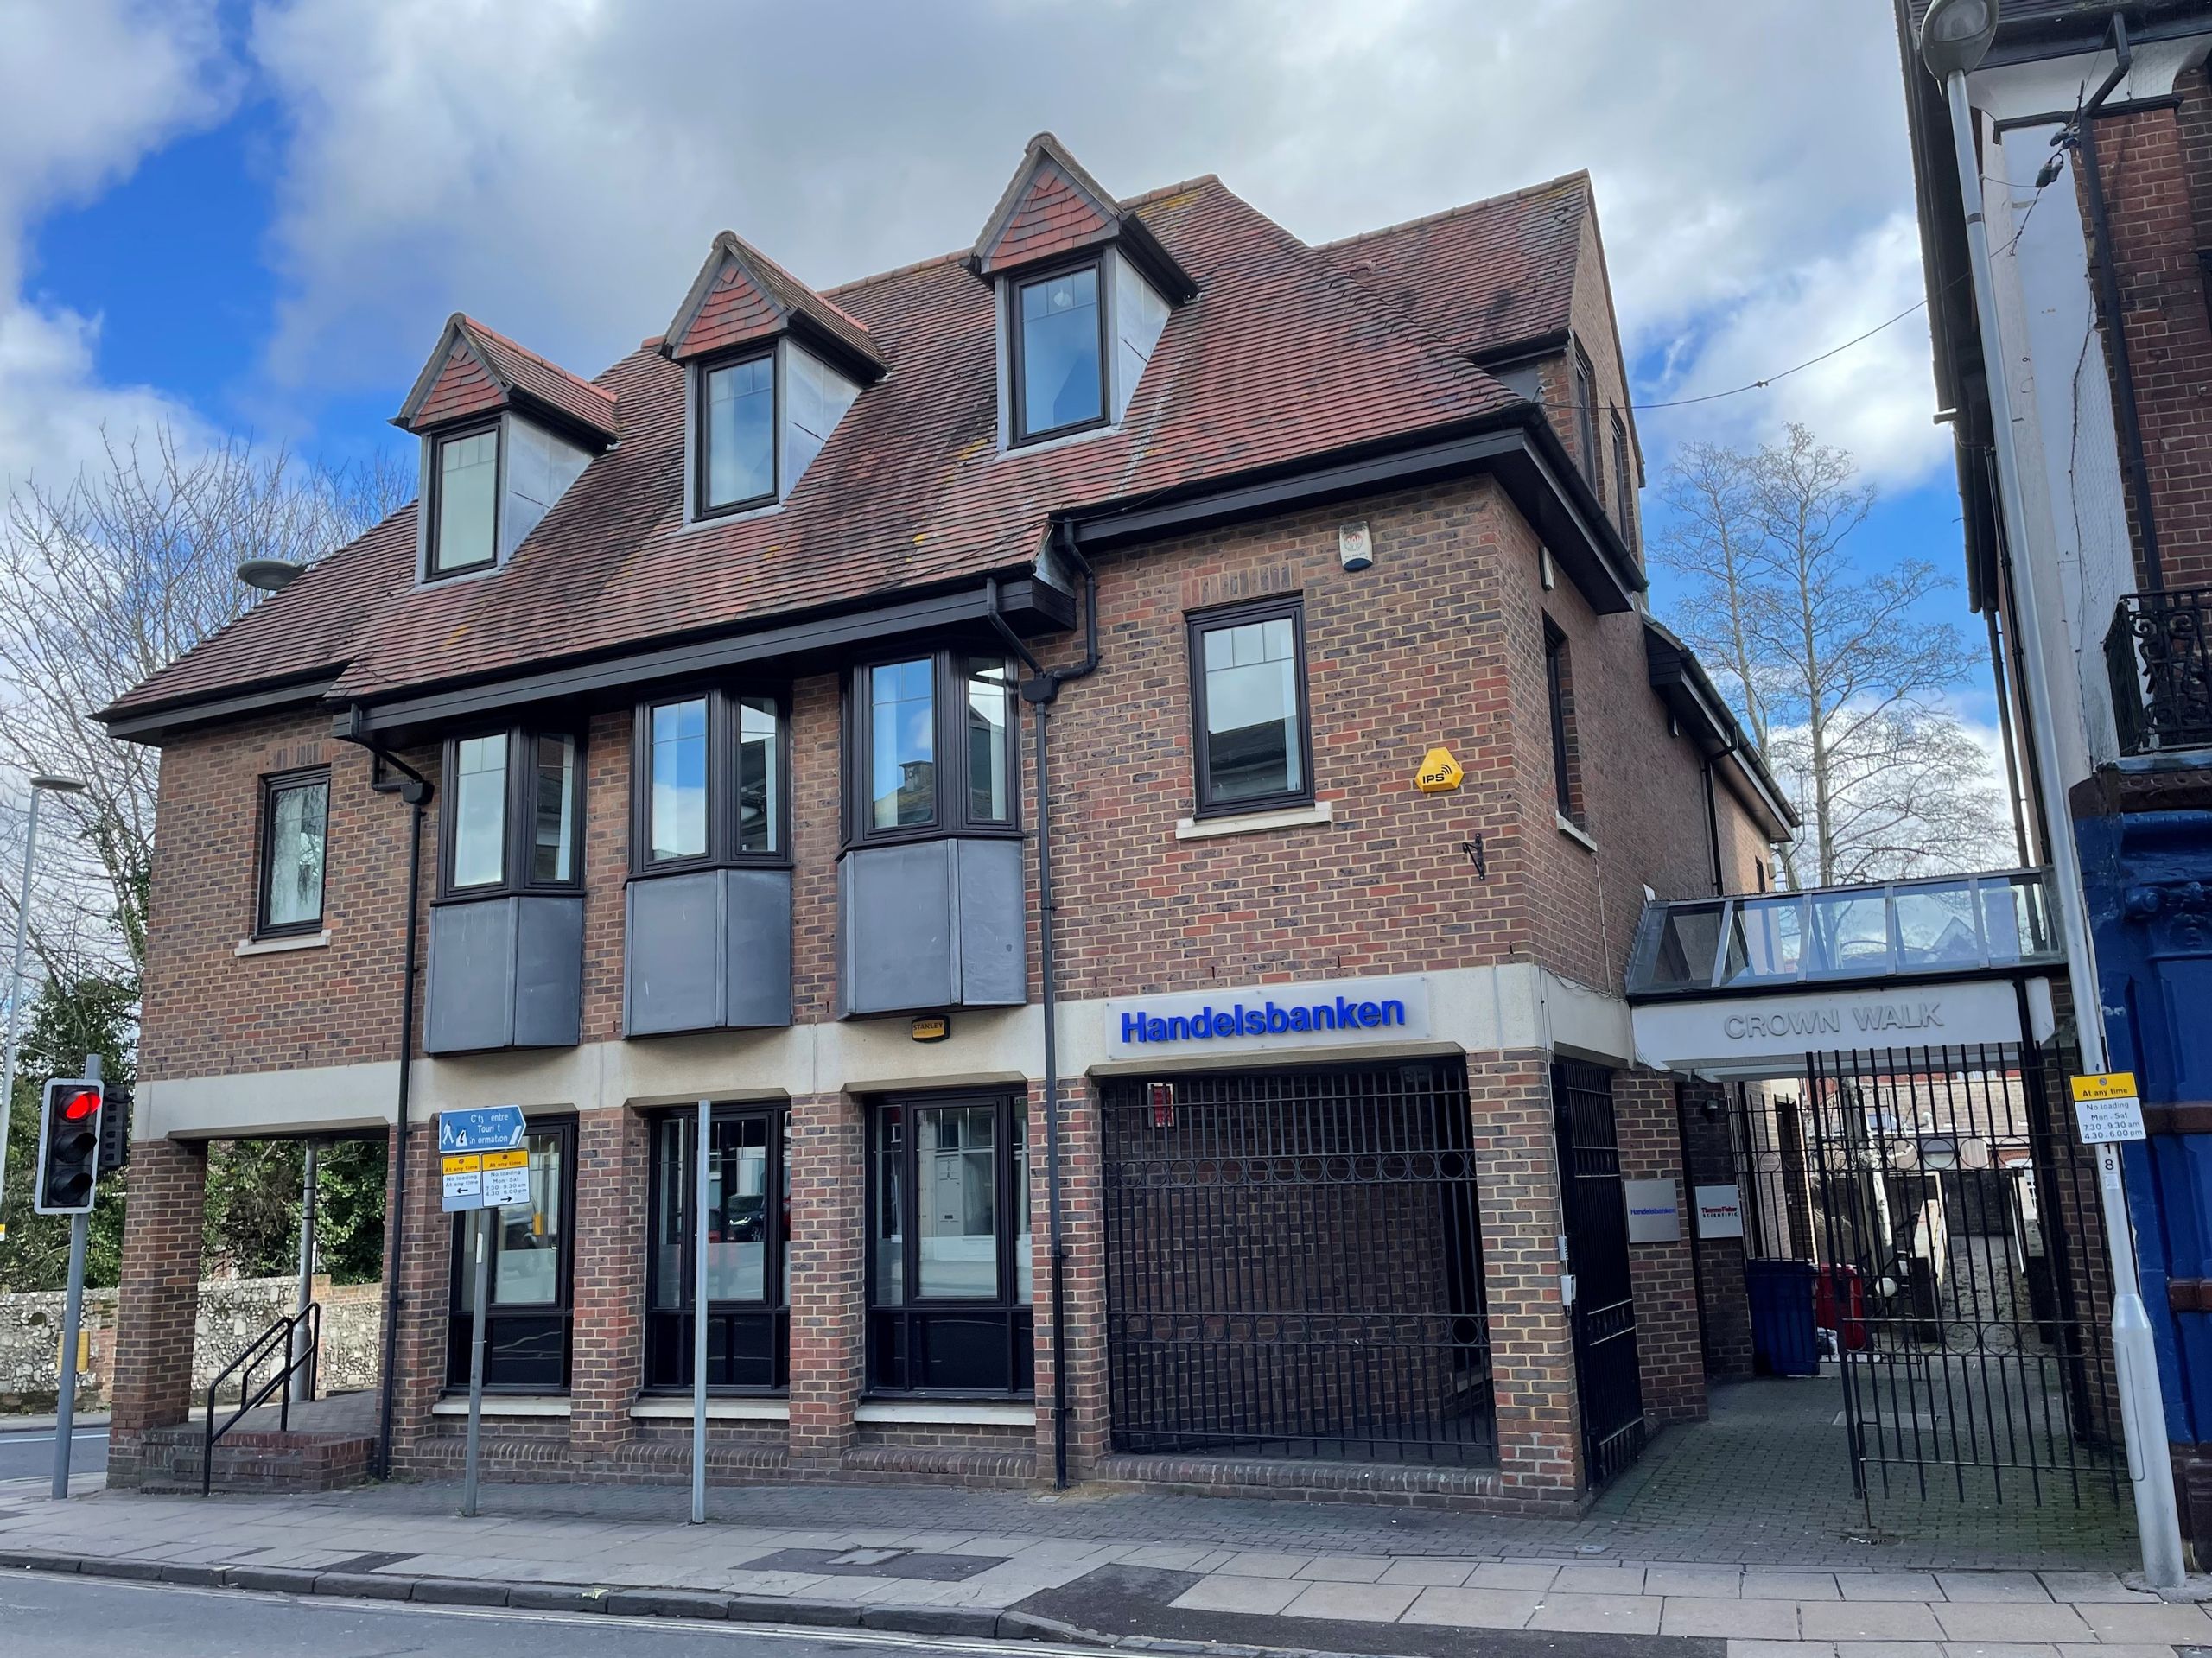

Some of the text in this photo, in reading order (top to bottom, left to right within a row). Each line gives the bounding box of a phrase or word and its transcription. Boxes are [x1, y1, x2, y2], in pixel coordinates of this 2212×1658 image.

[1422, 772, 1445, 784] IPS
[1122, 996, 1406, 1043] Handelsbanken
[1724, 1001, 1945, 1039] CROWN WALK
[2101, 1102, 2129, 1110] loading
[470, 1112, 508, 1124] Cty entre
[477, 1123, 501, 1133] Tourit
